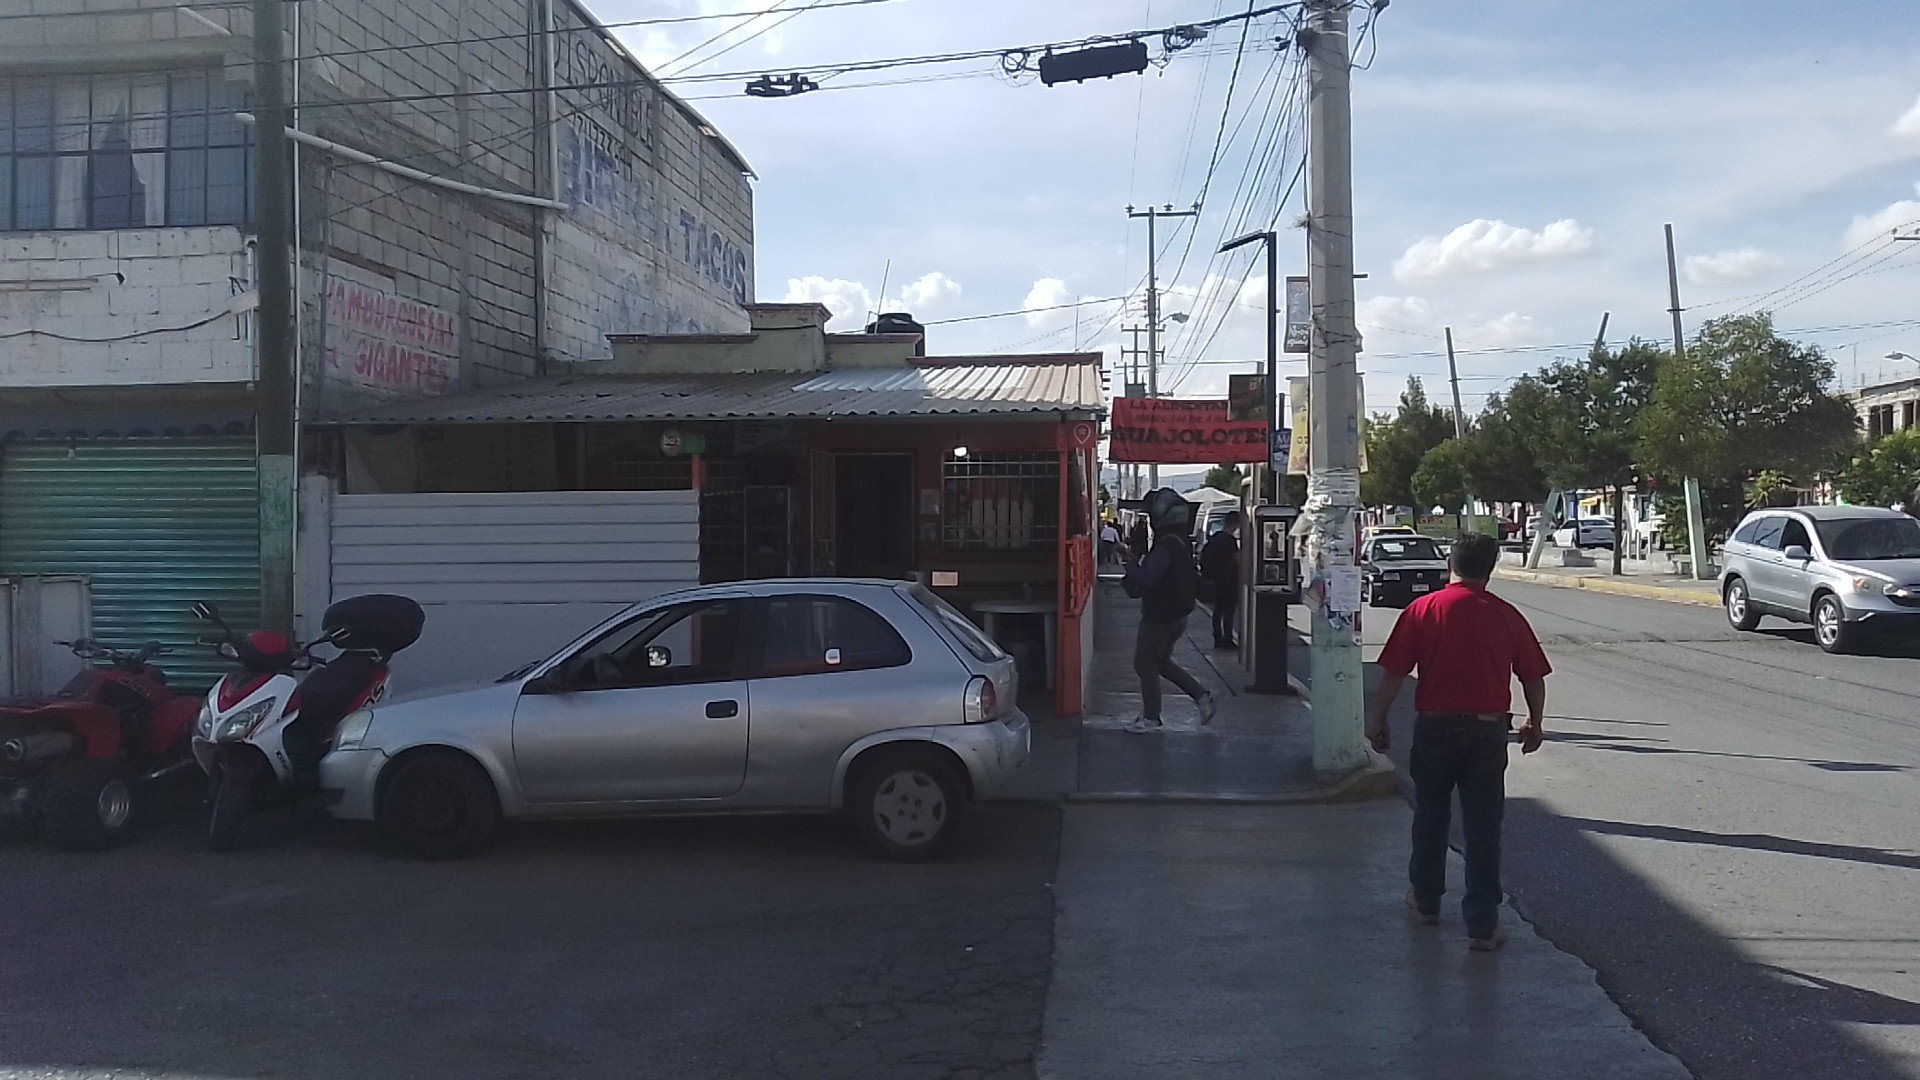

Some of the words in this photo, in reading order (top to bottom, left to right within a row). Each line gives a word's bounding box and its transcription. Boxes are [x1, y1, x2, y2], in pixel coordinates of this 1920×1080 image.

[679, 206, 747, 308] TACOS
[354, 335, 449, 394] GIGANTES
[1112, 426, 1267, 446] GUAJOLOTES
